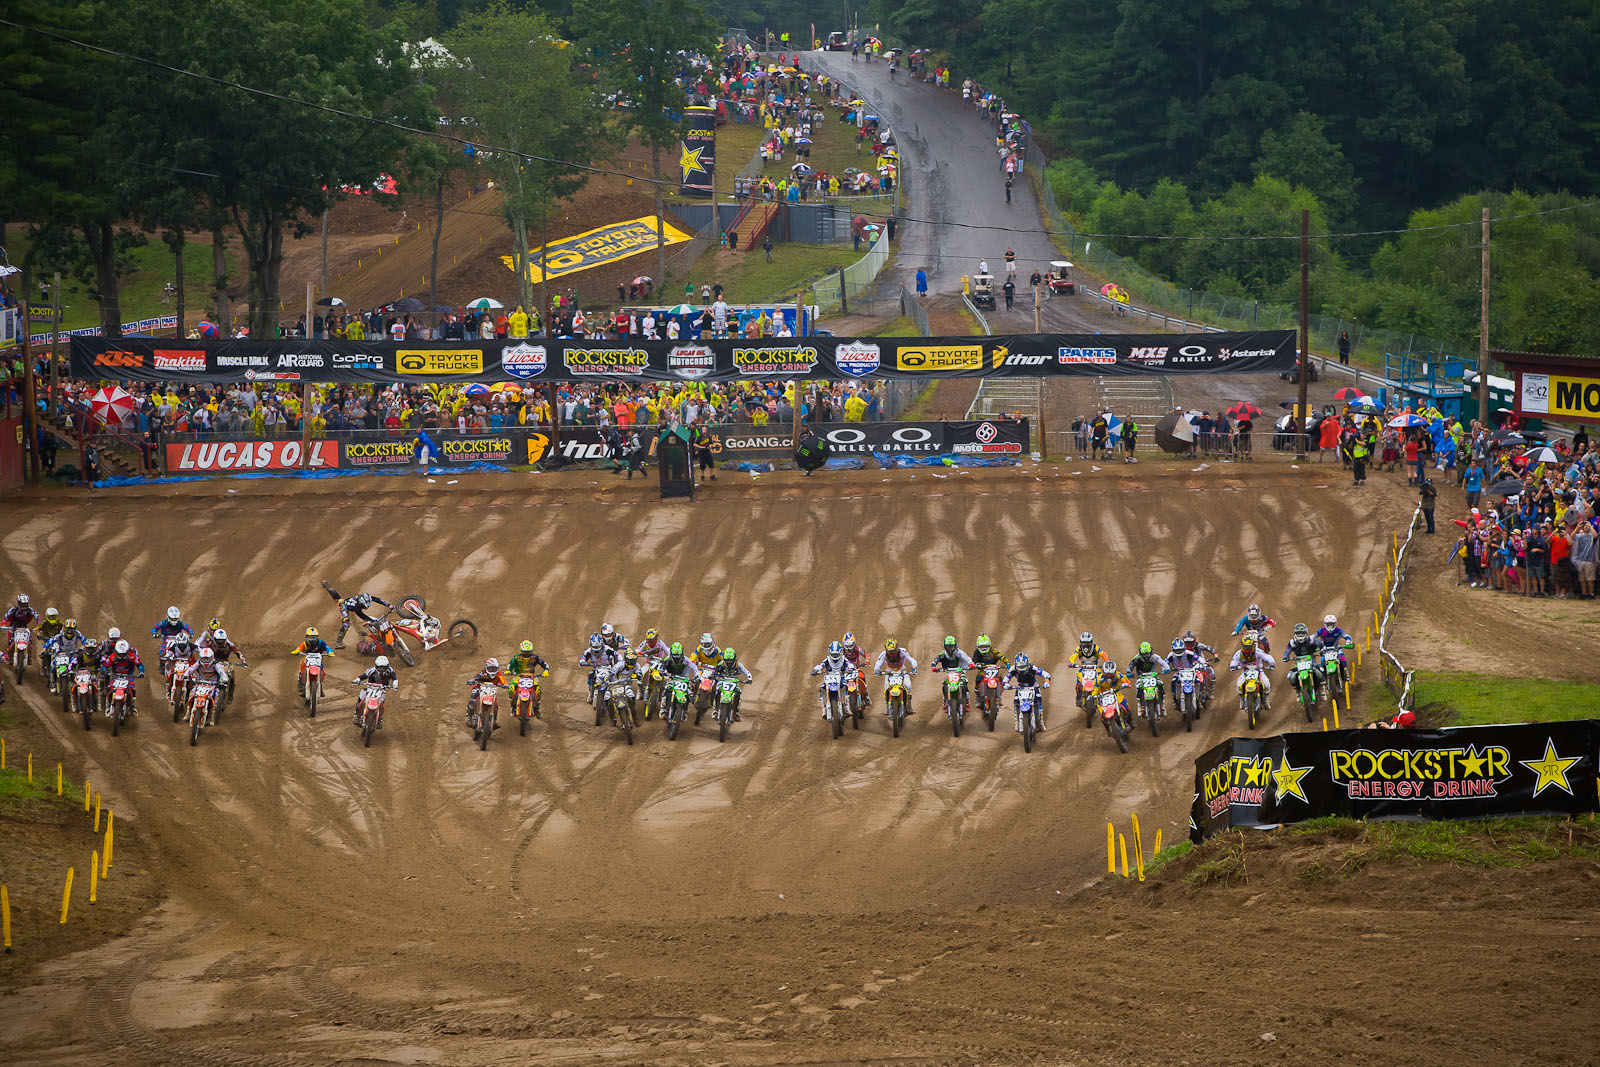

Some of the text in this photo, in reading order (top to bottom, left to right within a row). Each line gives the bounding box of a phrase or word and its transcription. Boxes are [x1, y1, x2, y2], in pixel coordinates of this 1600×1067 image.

[574, 227, 648, 251] TOYOTA
[585, 233, 659, 258] TRUCKS
[140, 319, 159, 327] PARTS
[735, 349, 815, 364] ROCKSTAR
[841, 352, 877, 361] LUCAS
[929, 350, 978, 358] TOYOTA
[1060, 348, 1116, 357] PARTS
[1127, 347, 1169, 359] MXS
[93, 350, 144, 367] KTM
[216, 356, 269, 366] MUSCLE MILK
[277, 354, 298, 367] AIR
[332, 353, 384, 363] GoPro
[508, 354, 543, 363] LUCAS
[565, 350, 647, 365] ROCKSTAR
[670, 356, 714, 366] MOTOCROSS
[929, 358, 978, 366] TRUCKS
[1005, 353, 1052, 365] thor
[1172, 355, 1213, 363] OAKLEY
[430, 362, 479, 370] TRUCKS
[613, 364, 640, 372] DRINK
[741, 363, 809, 372] ENERGY DRINK
[346, 442, 414, 457] ROCKSTAR
[444, 438, 512, 453] ROCKSTAR
[828, 444, 876, 452] AKLEY
[882, 443, 942, 451] OAKLEY
[953, 442, 1022, 453] motoworks
[179, 441, 275, 469] LUCAS
[352, 455, 409, 464] ENERGY DRINK
[450, 451, 506, 460] ENERGY DRINK
[947, 673, 960, 682] 15
[985, 669, 999, 678] 37
[519, 678, 534, 688] 36
[673, 682, 688, 691] 20
[1143, 678, 1157, 687] 28
[1332, 745, 1510, 780] ROCKSTAR
[1349, 779, 1496, 798] ENERGY DRINK
